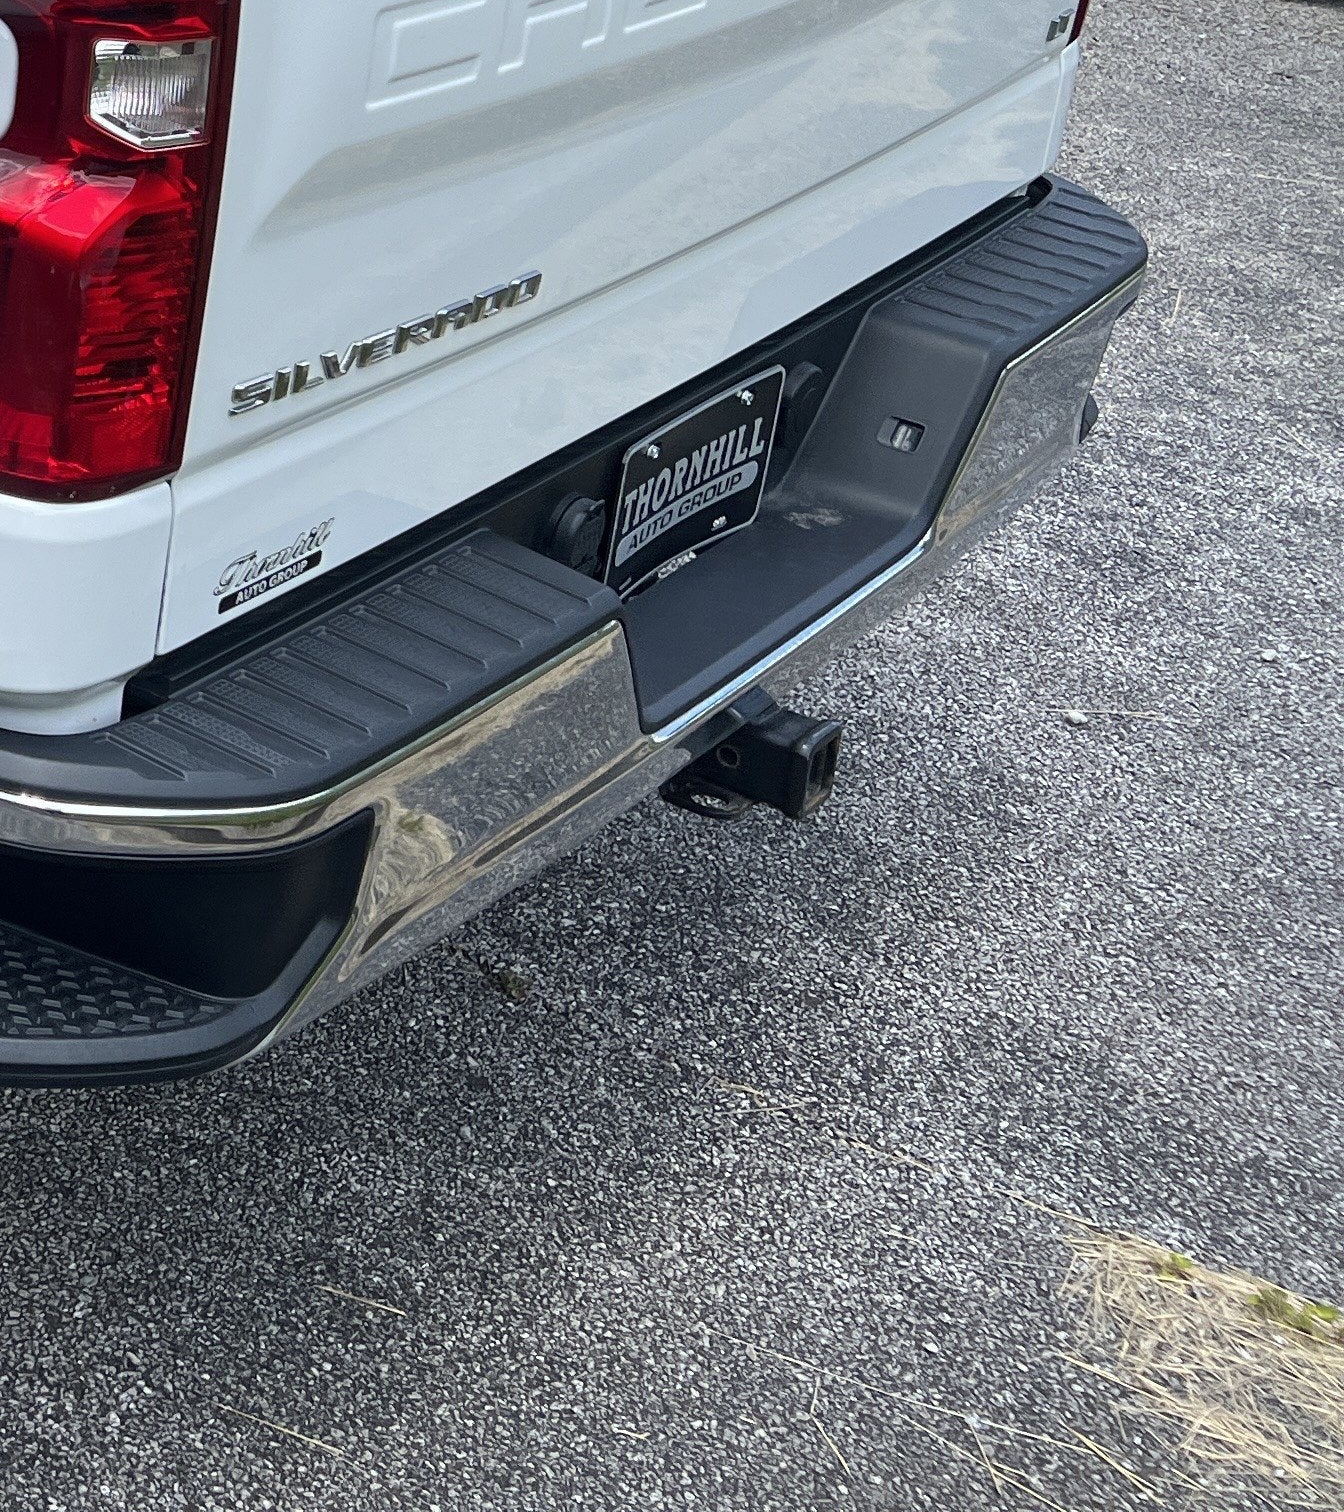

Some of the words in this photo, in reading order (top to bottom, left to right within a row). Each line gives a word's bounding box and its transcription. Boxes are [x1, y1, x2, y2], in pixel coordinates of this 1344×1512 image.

[227, 270, 542, 416] SILVERADO
[621, 416, 765, 534] THORNHILL
[627, 507, 673, 552] AUTO
[678, 472, 742, 517] GROUP
[235, 579, 267, 605] AUTO
[268, 559, 308, 588] GROUP
